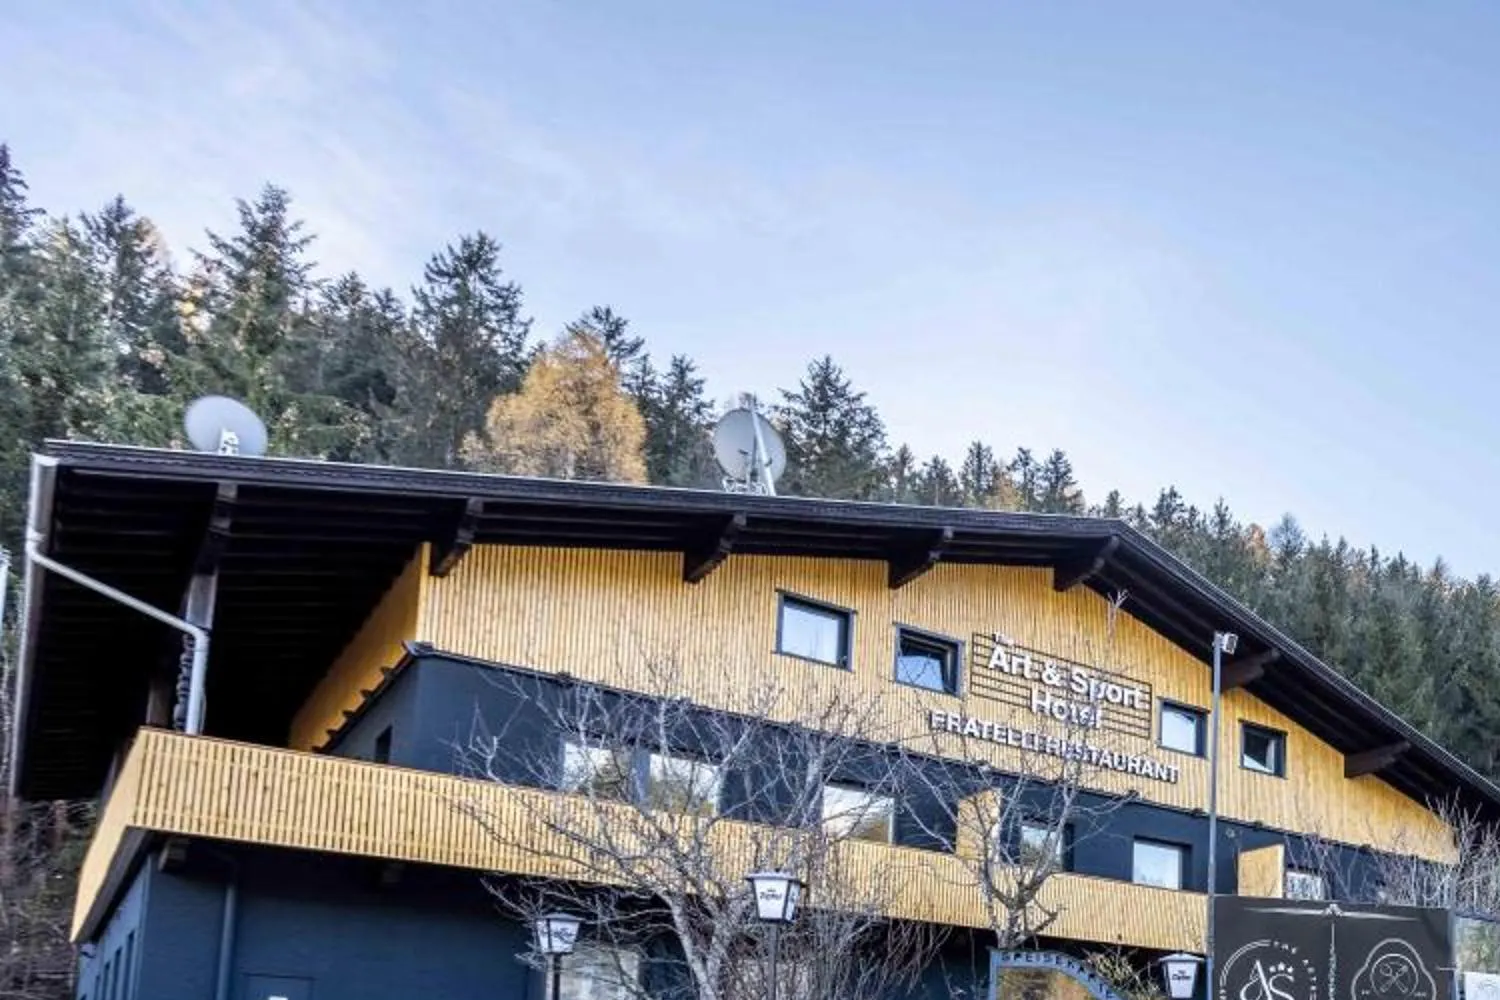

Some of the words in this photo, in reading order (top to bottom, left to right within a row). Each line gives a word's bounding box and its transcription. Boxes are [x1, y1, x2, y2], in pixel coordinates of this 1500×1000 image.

[988, 645, 1034, 680] Art
[1041, 661, 1063, 687] &
[1071, 667, 1144, 709] Sport
[1031, 688, 1101, 729] Hotel
[930, 711, 1040, 753] FRATELLI
